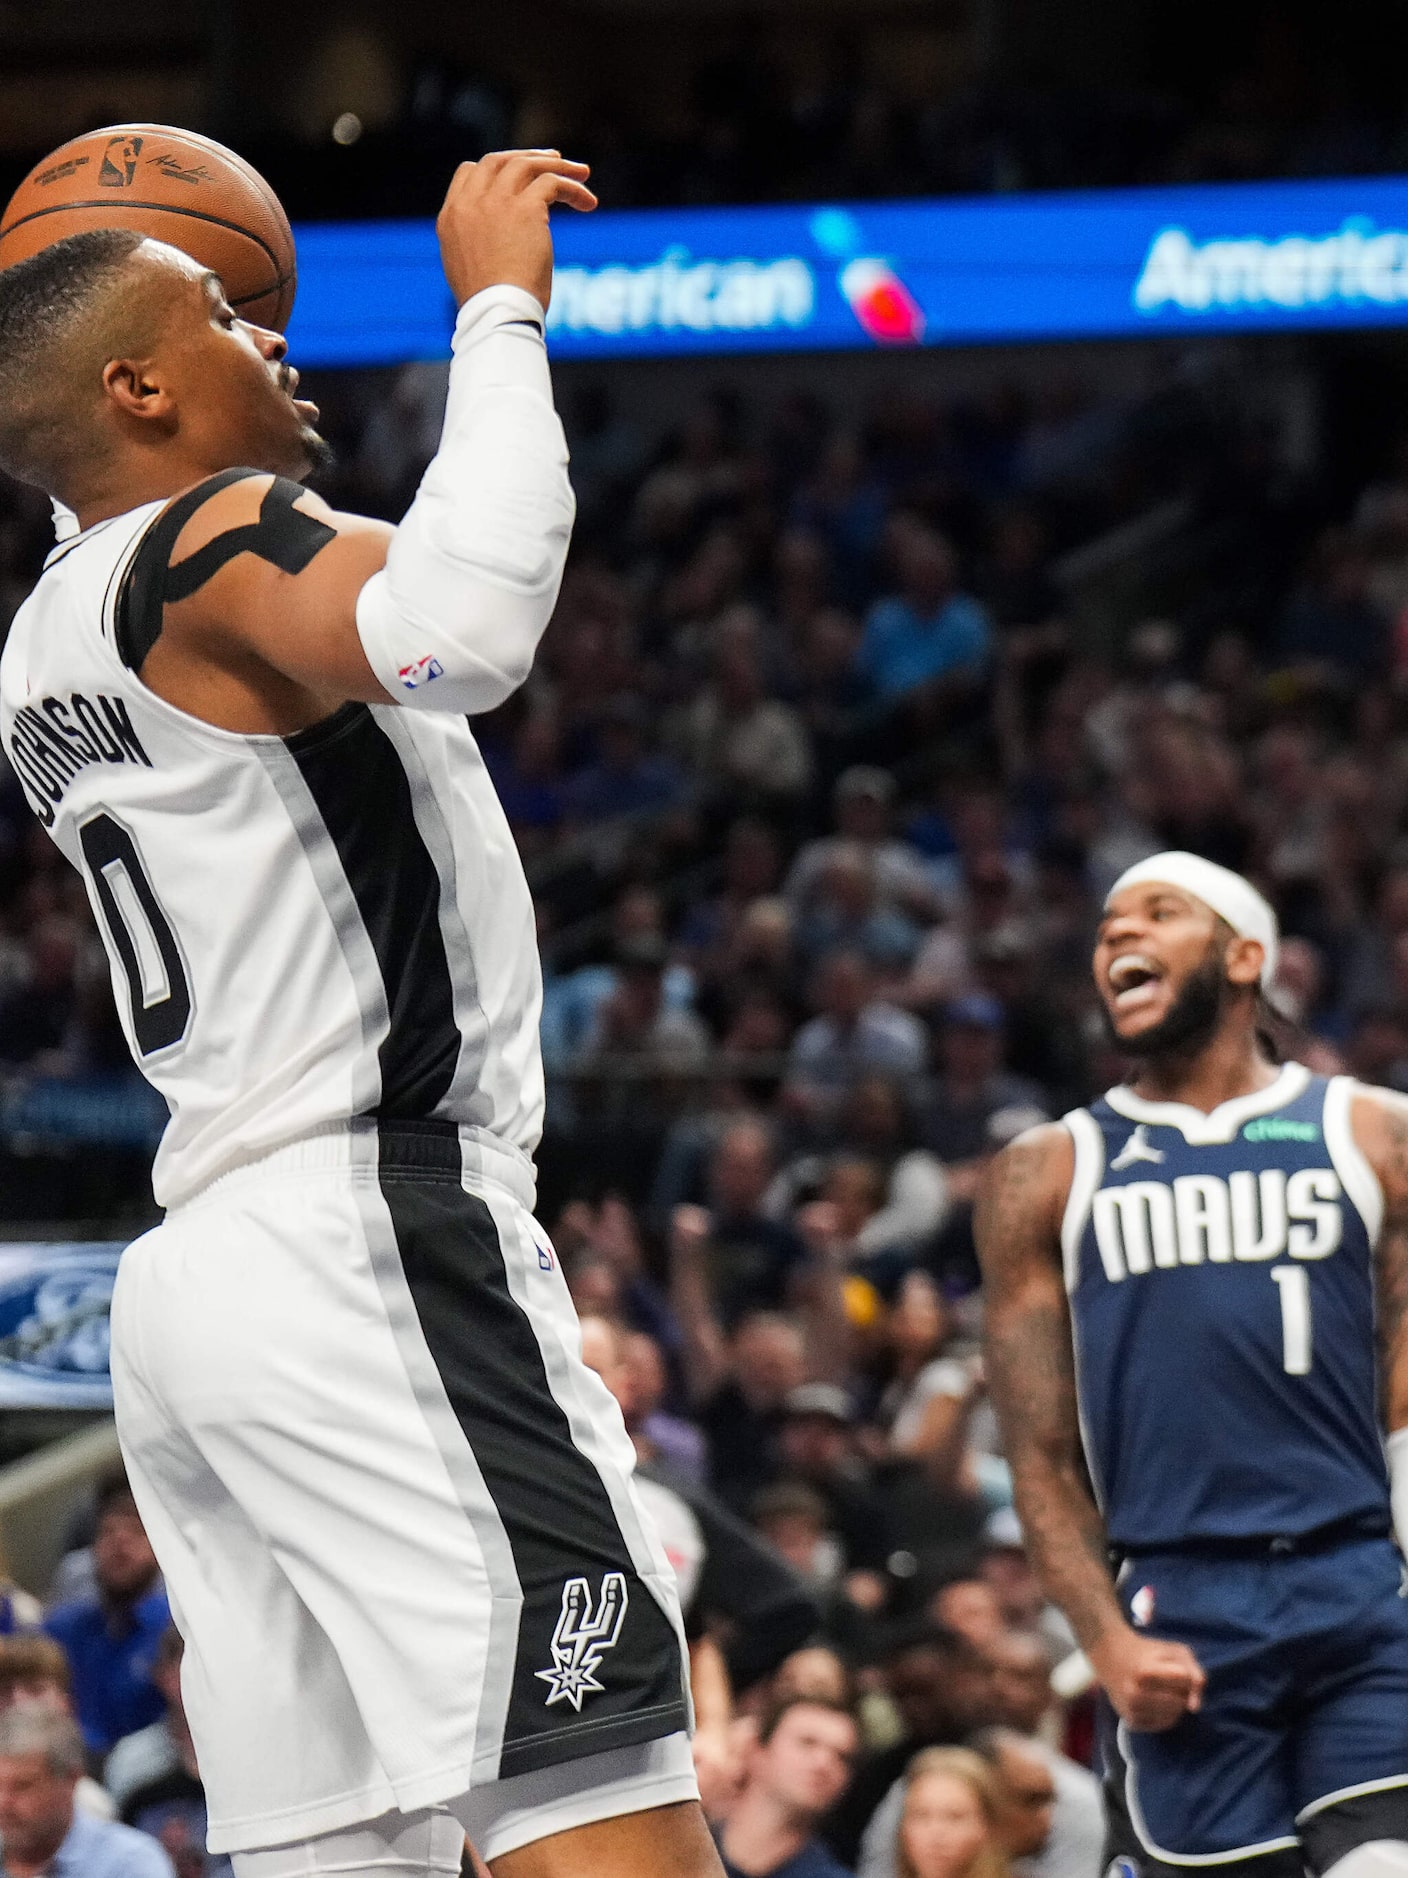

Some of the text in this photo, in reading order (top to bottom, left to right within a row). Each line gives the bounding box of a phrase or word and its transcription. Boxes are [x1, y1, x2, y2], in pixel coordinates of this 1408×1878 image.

[546, 244, 815, 336] merican
[11, 693, 153, 827] JOHNSON
[75, 803, 196, 1068] 0
[1093, 1168, 1343, 1283] MAVS
[1271, 1265, 1311, 1375] 1
